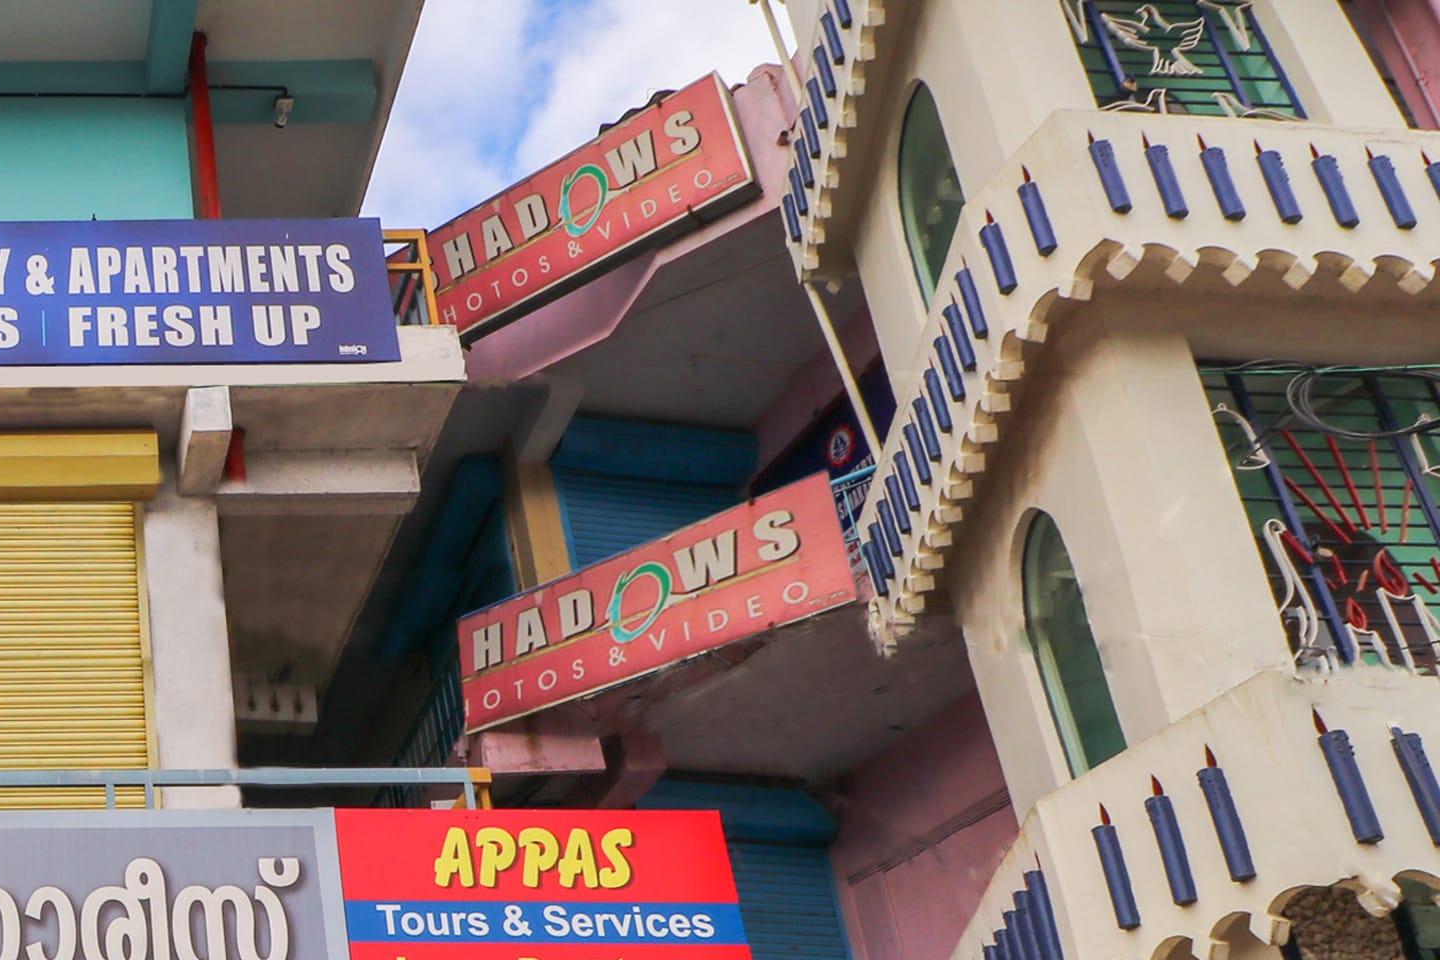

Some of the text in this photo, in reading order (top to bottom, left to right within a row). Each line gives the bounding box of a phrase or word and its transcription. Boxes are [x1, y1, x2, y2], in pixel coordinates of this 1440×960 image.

[25, 252, 56, 296] &
[67, 243, 356, 294] APARTMENTS
[443, 168, 714, 325] HOTOS & VIDEO
[67, 304, 234, 348] FRESH
[251, 304, 321, 347] UP
[608, 647, 627, 668] &
[648, 580, 810, 652] VIDEO
[434, 826, 634, 889] APPAS
[376, 903, 716, 939] Tours & Services
